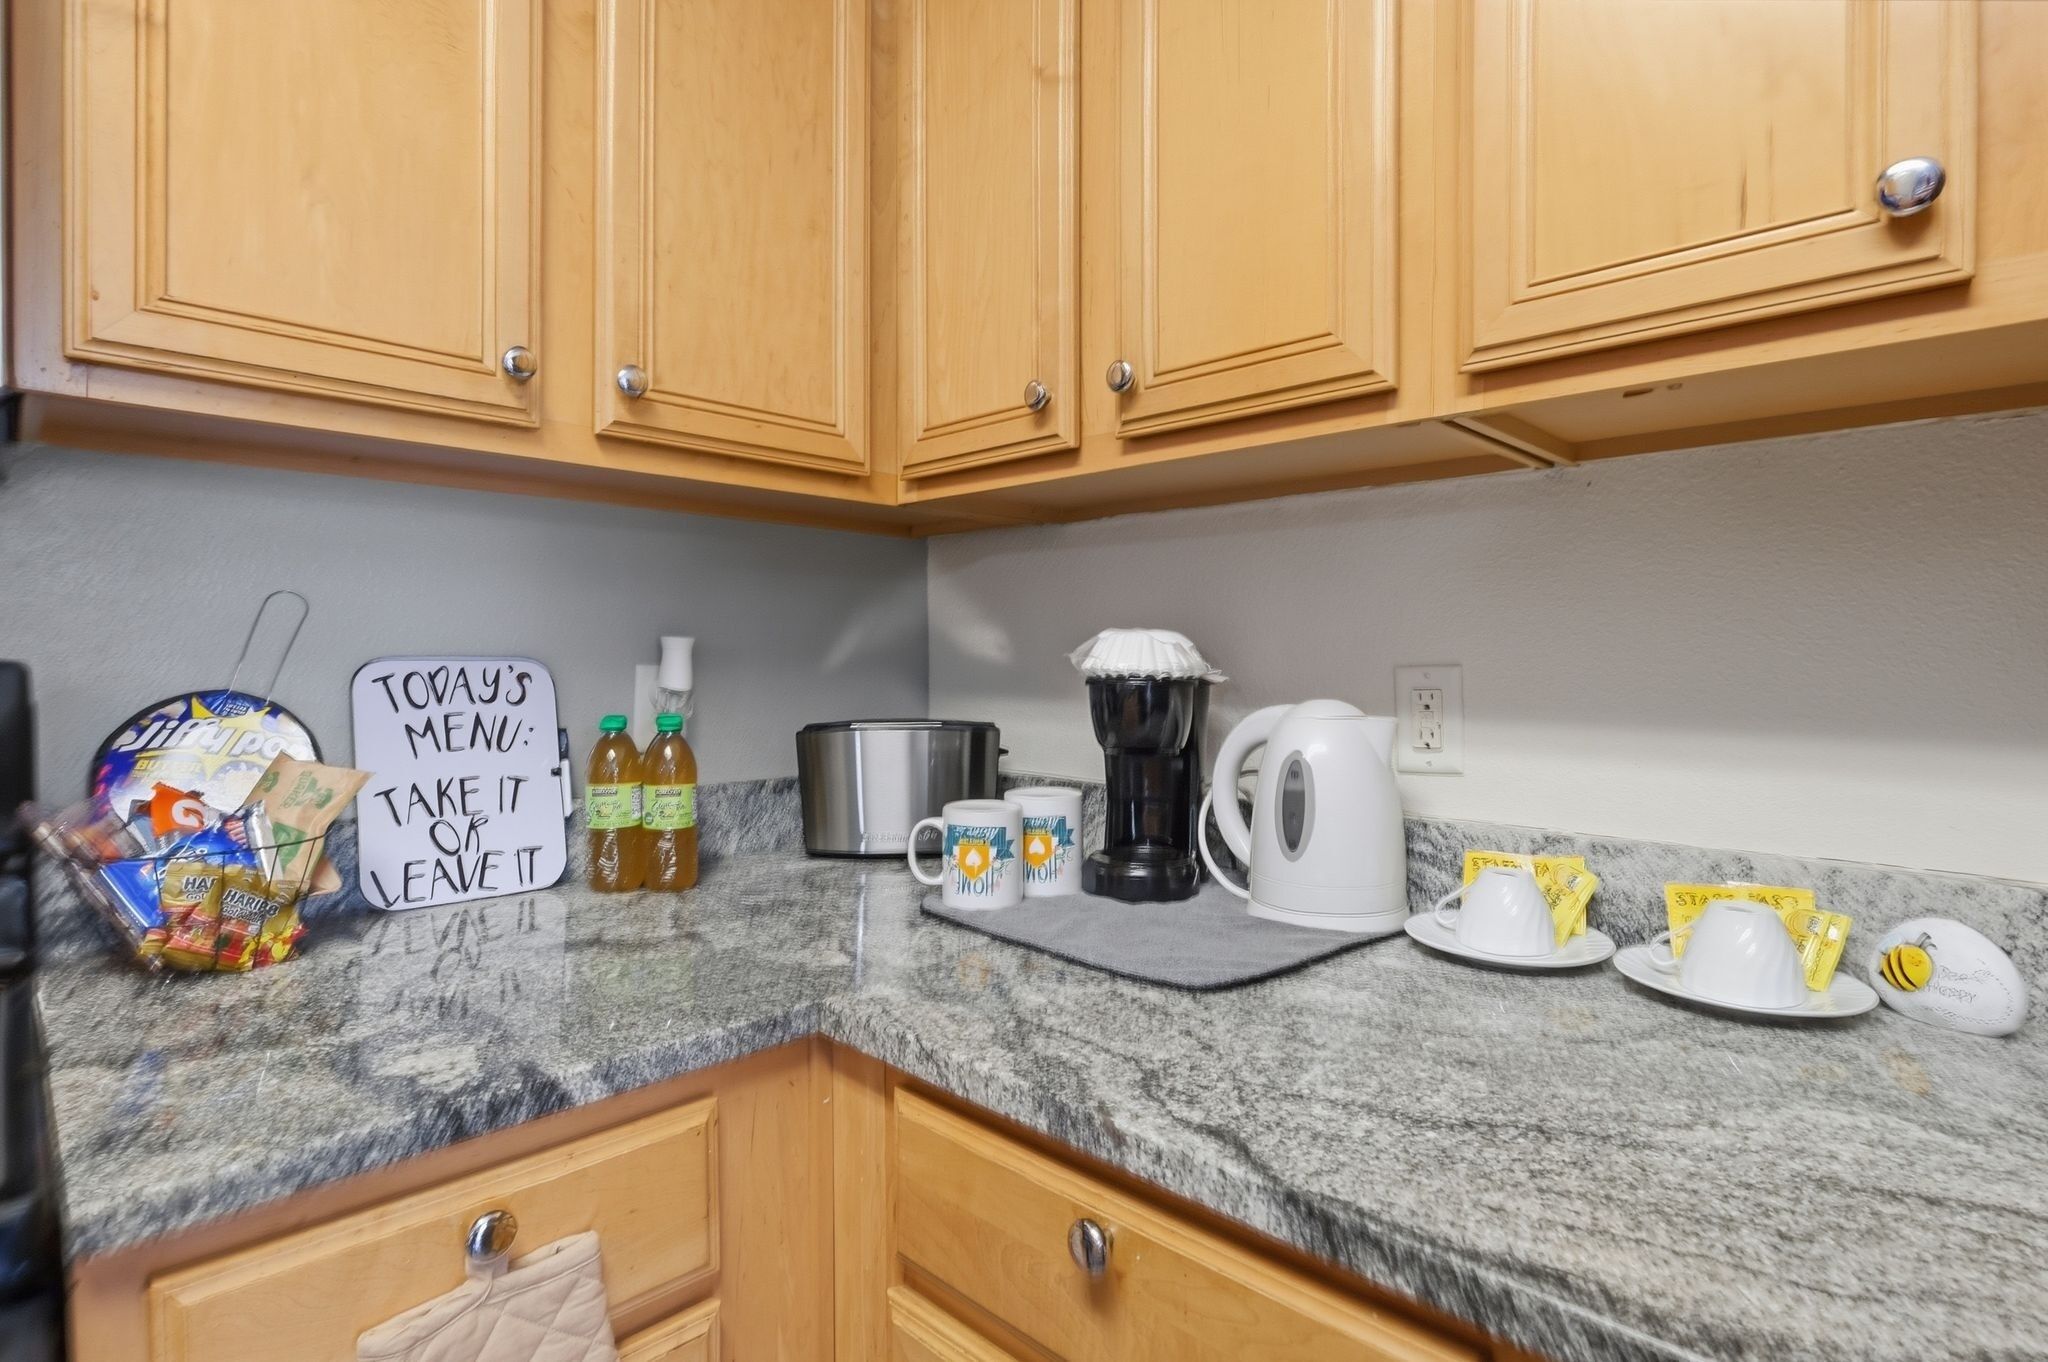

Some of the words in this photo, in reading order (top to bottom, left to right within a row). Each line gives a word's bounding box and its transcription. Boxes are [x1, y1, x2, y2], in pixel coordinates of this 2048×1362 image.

[371, 665, 533, 713] TODAY'S
[404, 711, 535, 759] MENU:
[373, 775, 484, 827] TAKE
[499, 775, 529, 814] IT
[428, 815, 489, 857] OR
[370, 850, 505, 909] LEAVE
[514, 846, 543, 887] IT
